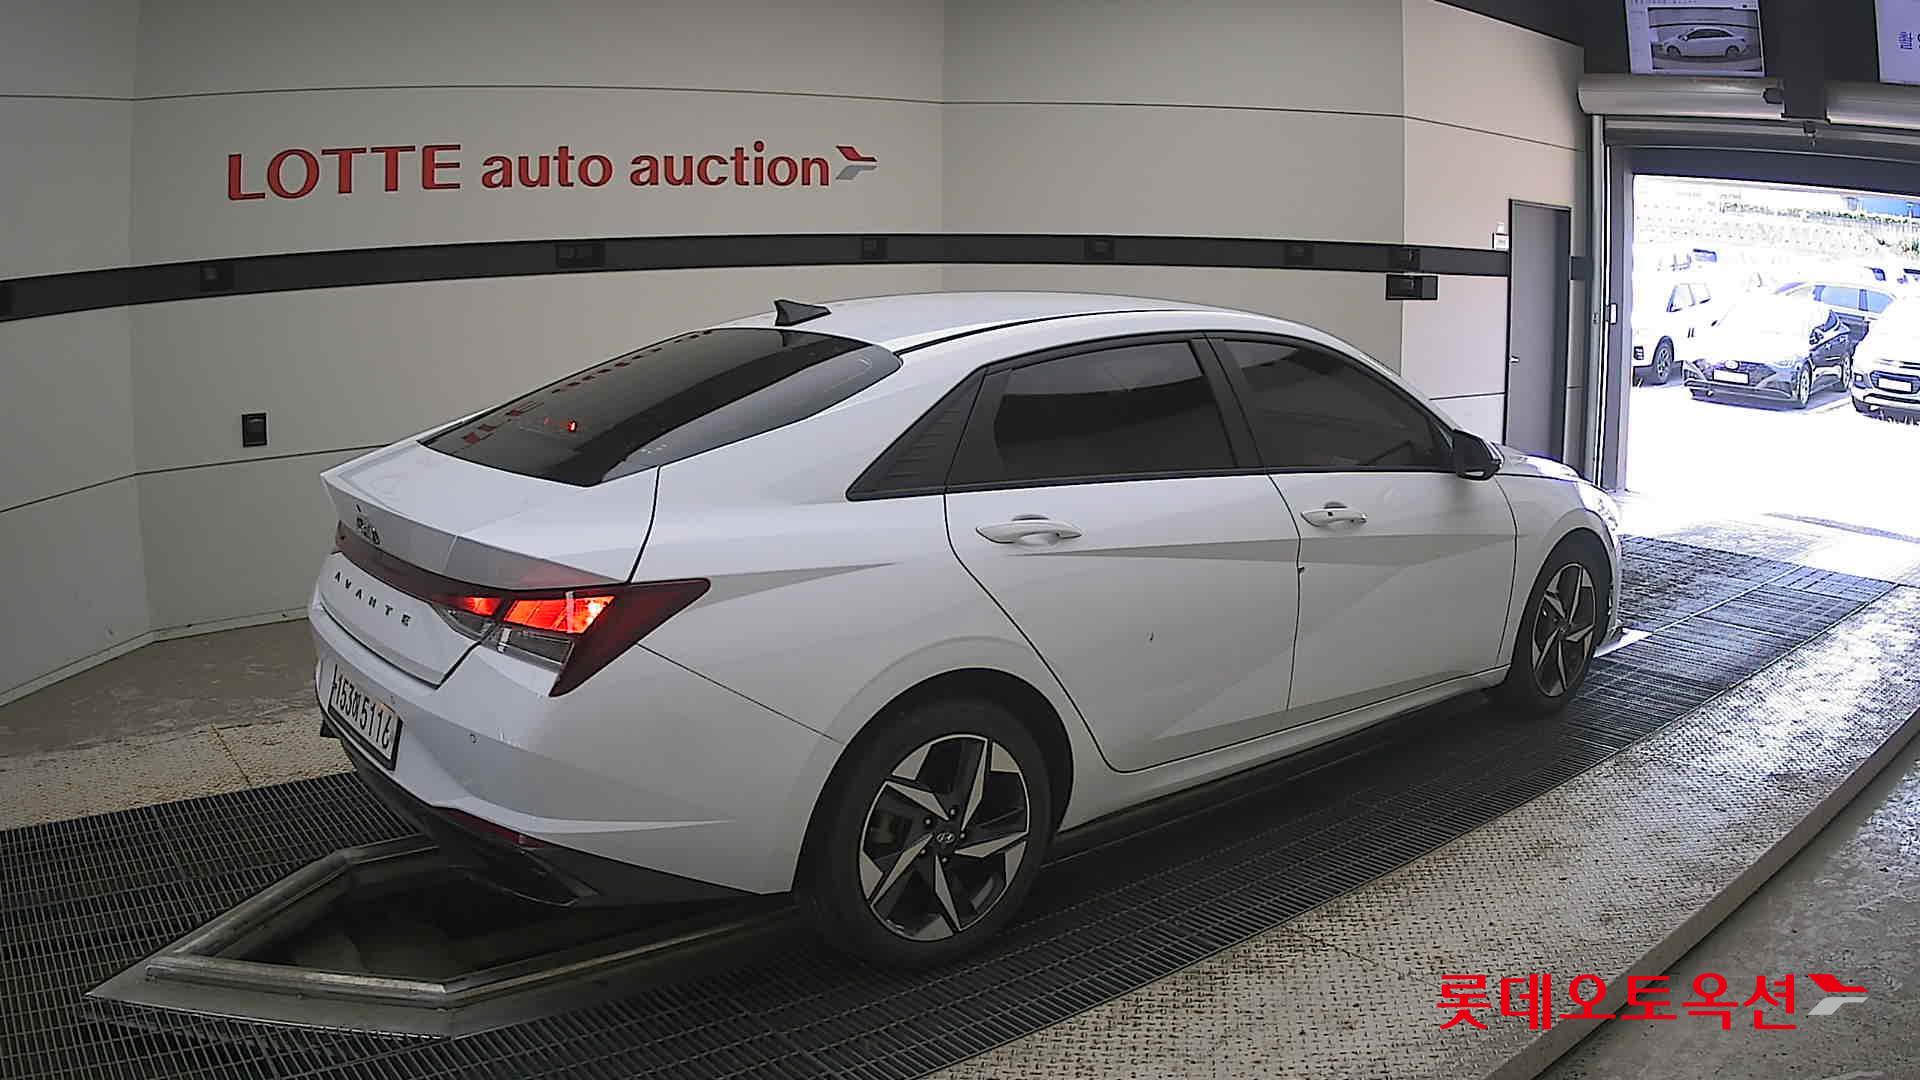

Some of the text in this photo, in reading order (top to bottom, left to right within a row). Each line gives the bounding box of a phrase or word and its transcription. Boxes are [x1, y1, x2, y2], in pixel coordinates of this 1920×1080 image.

[227, 140, 830, 200] LOTTE auto auction
[334, 571, 411, 627] AVANTE
